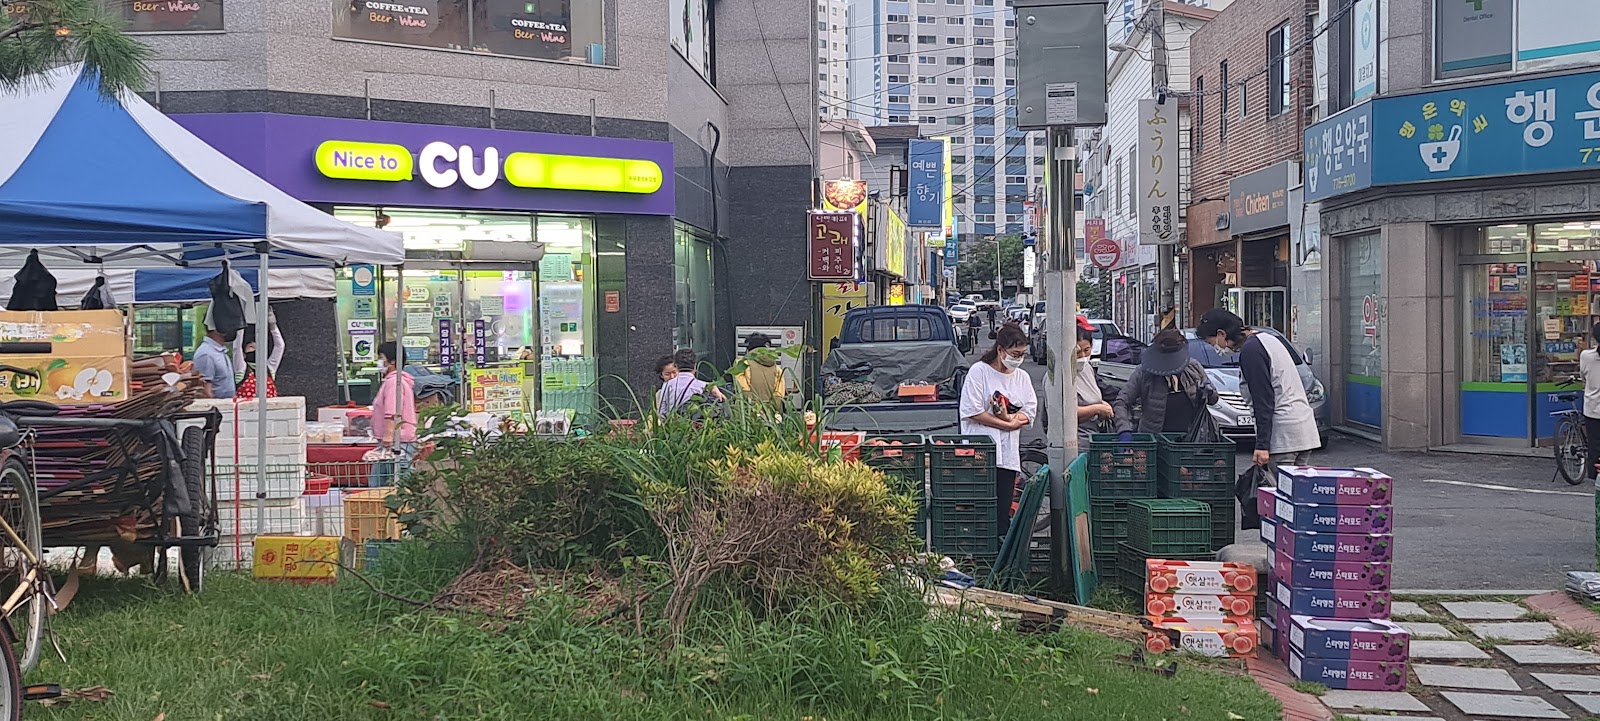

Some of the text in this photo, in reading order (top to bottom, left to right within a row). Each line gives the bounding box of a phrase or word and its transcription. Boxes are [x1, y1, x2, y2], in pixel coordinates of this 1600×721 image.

[133, 1, 200, 12] Beer Wine
[369, 12, 427, 28] Beer Wine
[514, 29, 565, 43] Beer Wine
[1147, 107, 1167, 199] ふうりん
[1322, 115, 1369, 176] 행운약국
[334, 150, 398, 170] Nice to
[419, 141, 499, 190] CU
[912, 160, 937, 178] 예쁜
[916, 184, 939, 204] 향기
[1245, 192, 1270, 216] Chicken
[816, 224, 848, 245] 고래
[441, 329, 450, 364] 당기세요
[476, 329, 485, 364] 당기세요
[1338, 484, 1361, 495] 스타포도
[1338, 515, 1361, 526] 스타포도
[1337, 542, 1360, 553] 스타포도
[1185, 572, 1206, 587] 햇살
[1335, 569, 1359, 580] 스타포도
[1182, 596, 1203, 610] 햇살
[1336, 597, 1360, 609] 스타포도
[1182, 634, 1204, 649] 햇살
[1352, 638, 1377, 650] 스타포도
[1349, 668, 1374, 680] 스타포도
